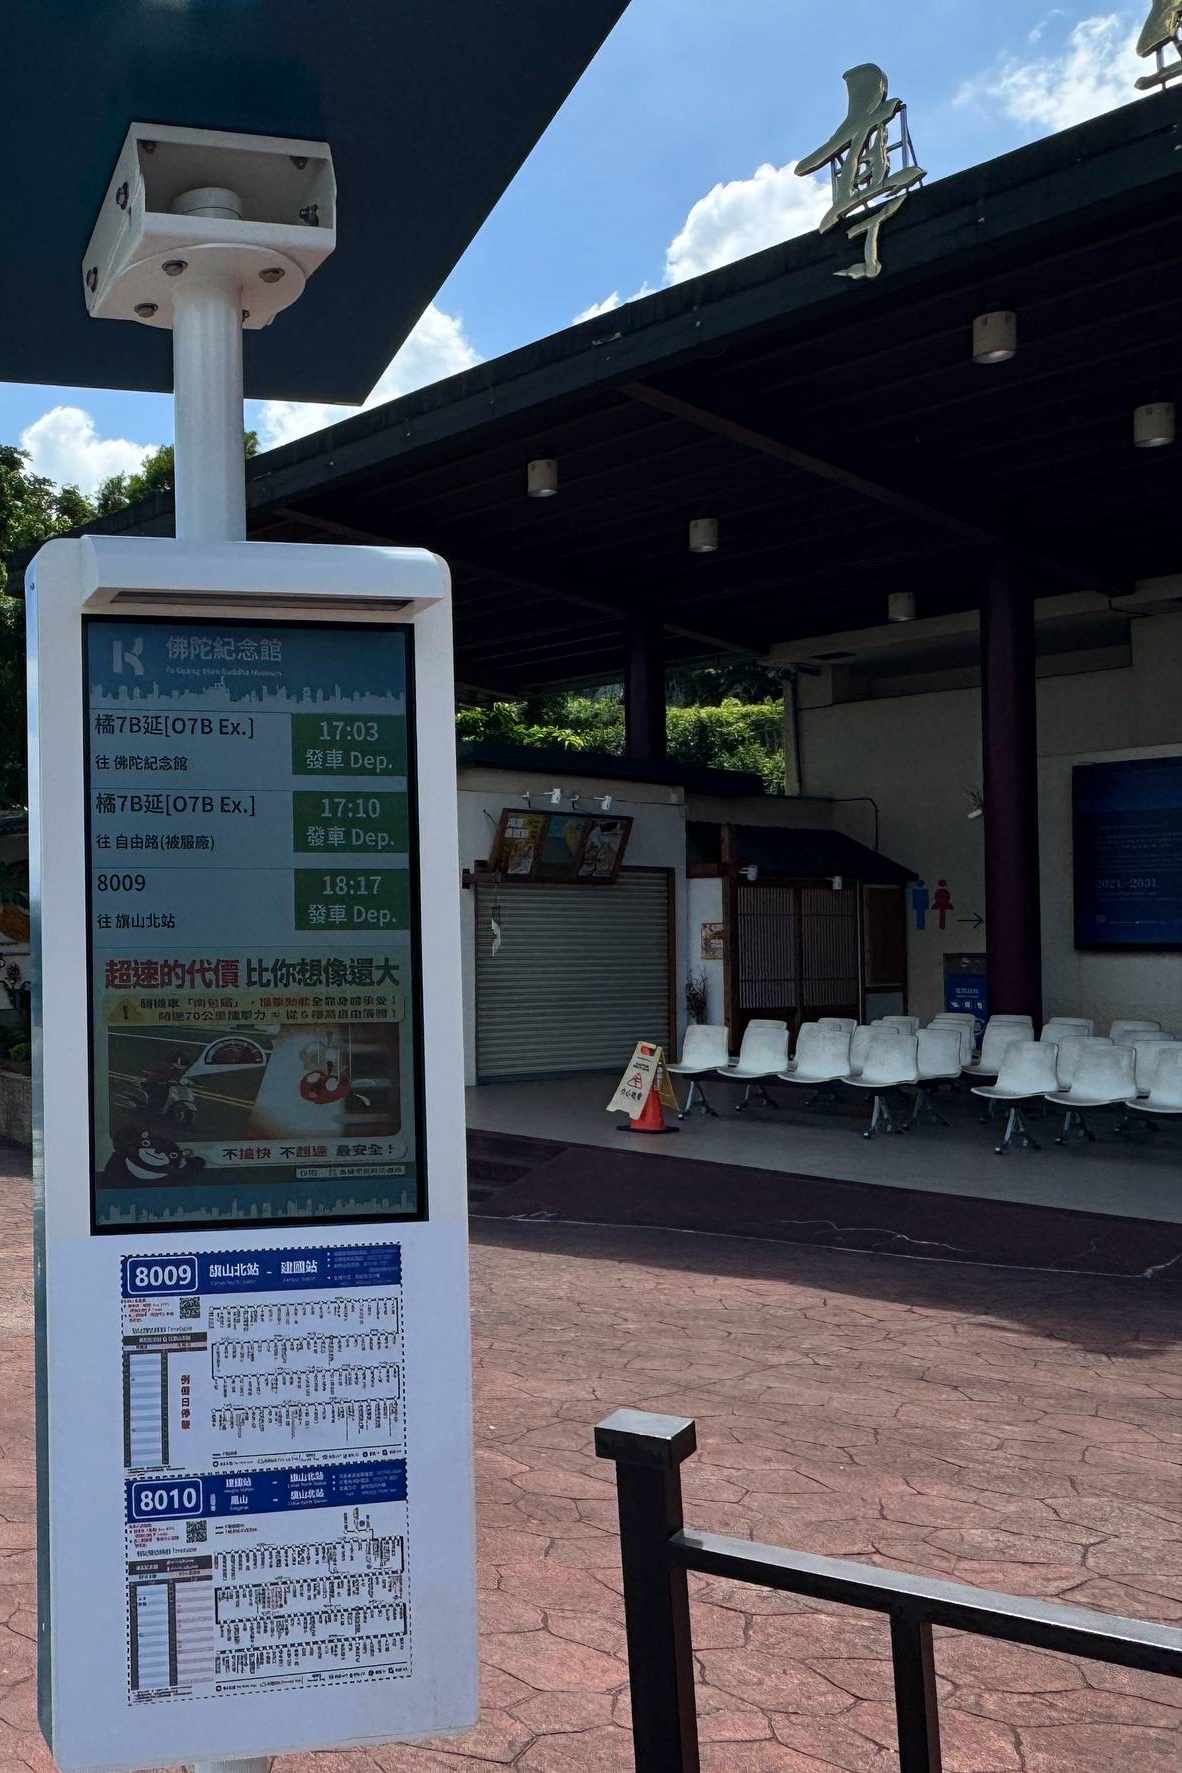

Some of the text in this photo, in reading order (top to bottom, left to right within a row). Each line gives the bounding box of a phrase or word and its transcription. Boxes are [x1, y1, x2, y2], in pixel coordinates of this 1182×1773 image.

[165, 635, 282, 663] 佛陀紀念館
[219, 717, 254, 739] Ex.]
[319, 721, 379, 741] 17:03
[306, 749, 393, 773] 發車 Dep.
[220, 796, 255, 818] Ex.]
[321, 798, 380, 818] 17:10
[307, 827, 395, 850] 發車 Dep.
[97, 874, 146, 892] 8009
[322, 876, 382, 895] 18:17
[309, 905, 397, 927] 發車 Dep.
[105, 957, 400, 989] 超速的代價 比你想像還大
[135, 1265, 192, 1287] 8009
[140, 1488, 197, 1511] 8010
